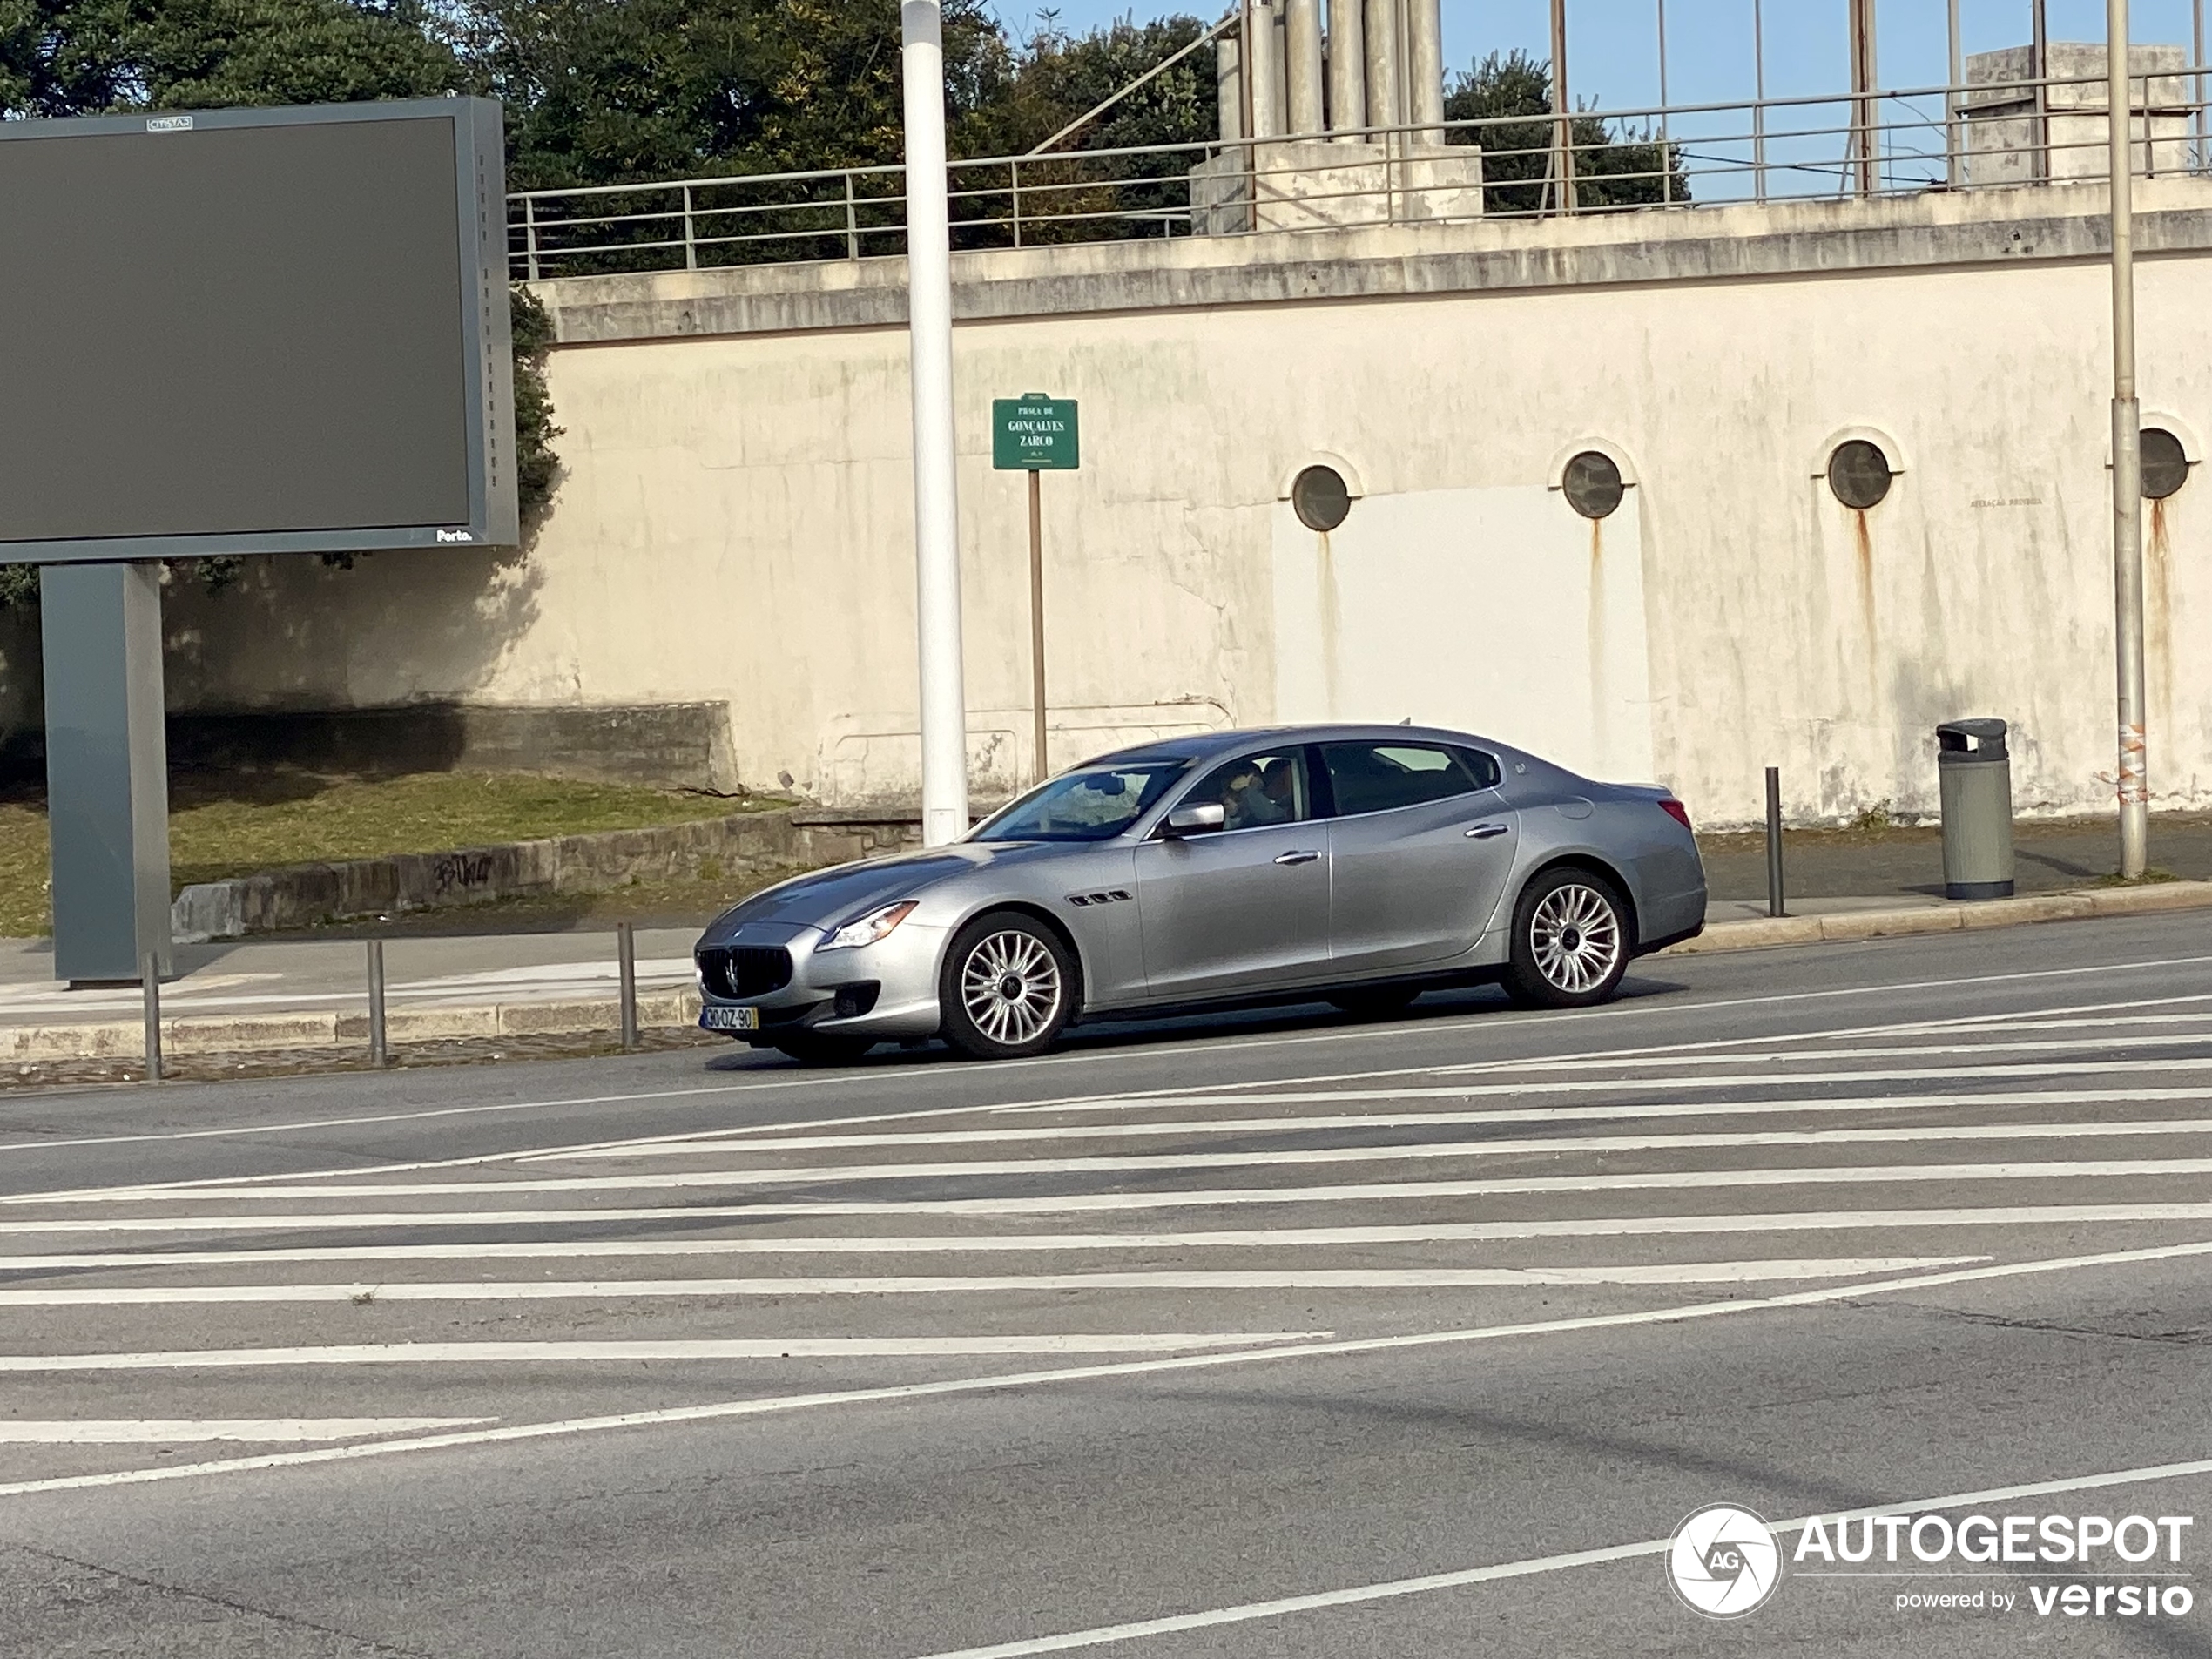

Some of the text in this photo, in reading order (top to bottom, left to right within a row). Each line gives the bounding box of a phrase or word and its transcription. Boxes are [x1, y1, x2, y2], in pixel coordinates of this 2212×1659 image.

[1018, 407, 1042, 416] PRAÇA
[1008, 421, 1065, 434] GONÇALVES
[1020, 435, 1054, 447] ZARCO
[436, 529, 473, 543] Porto.
